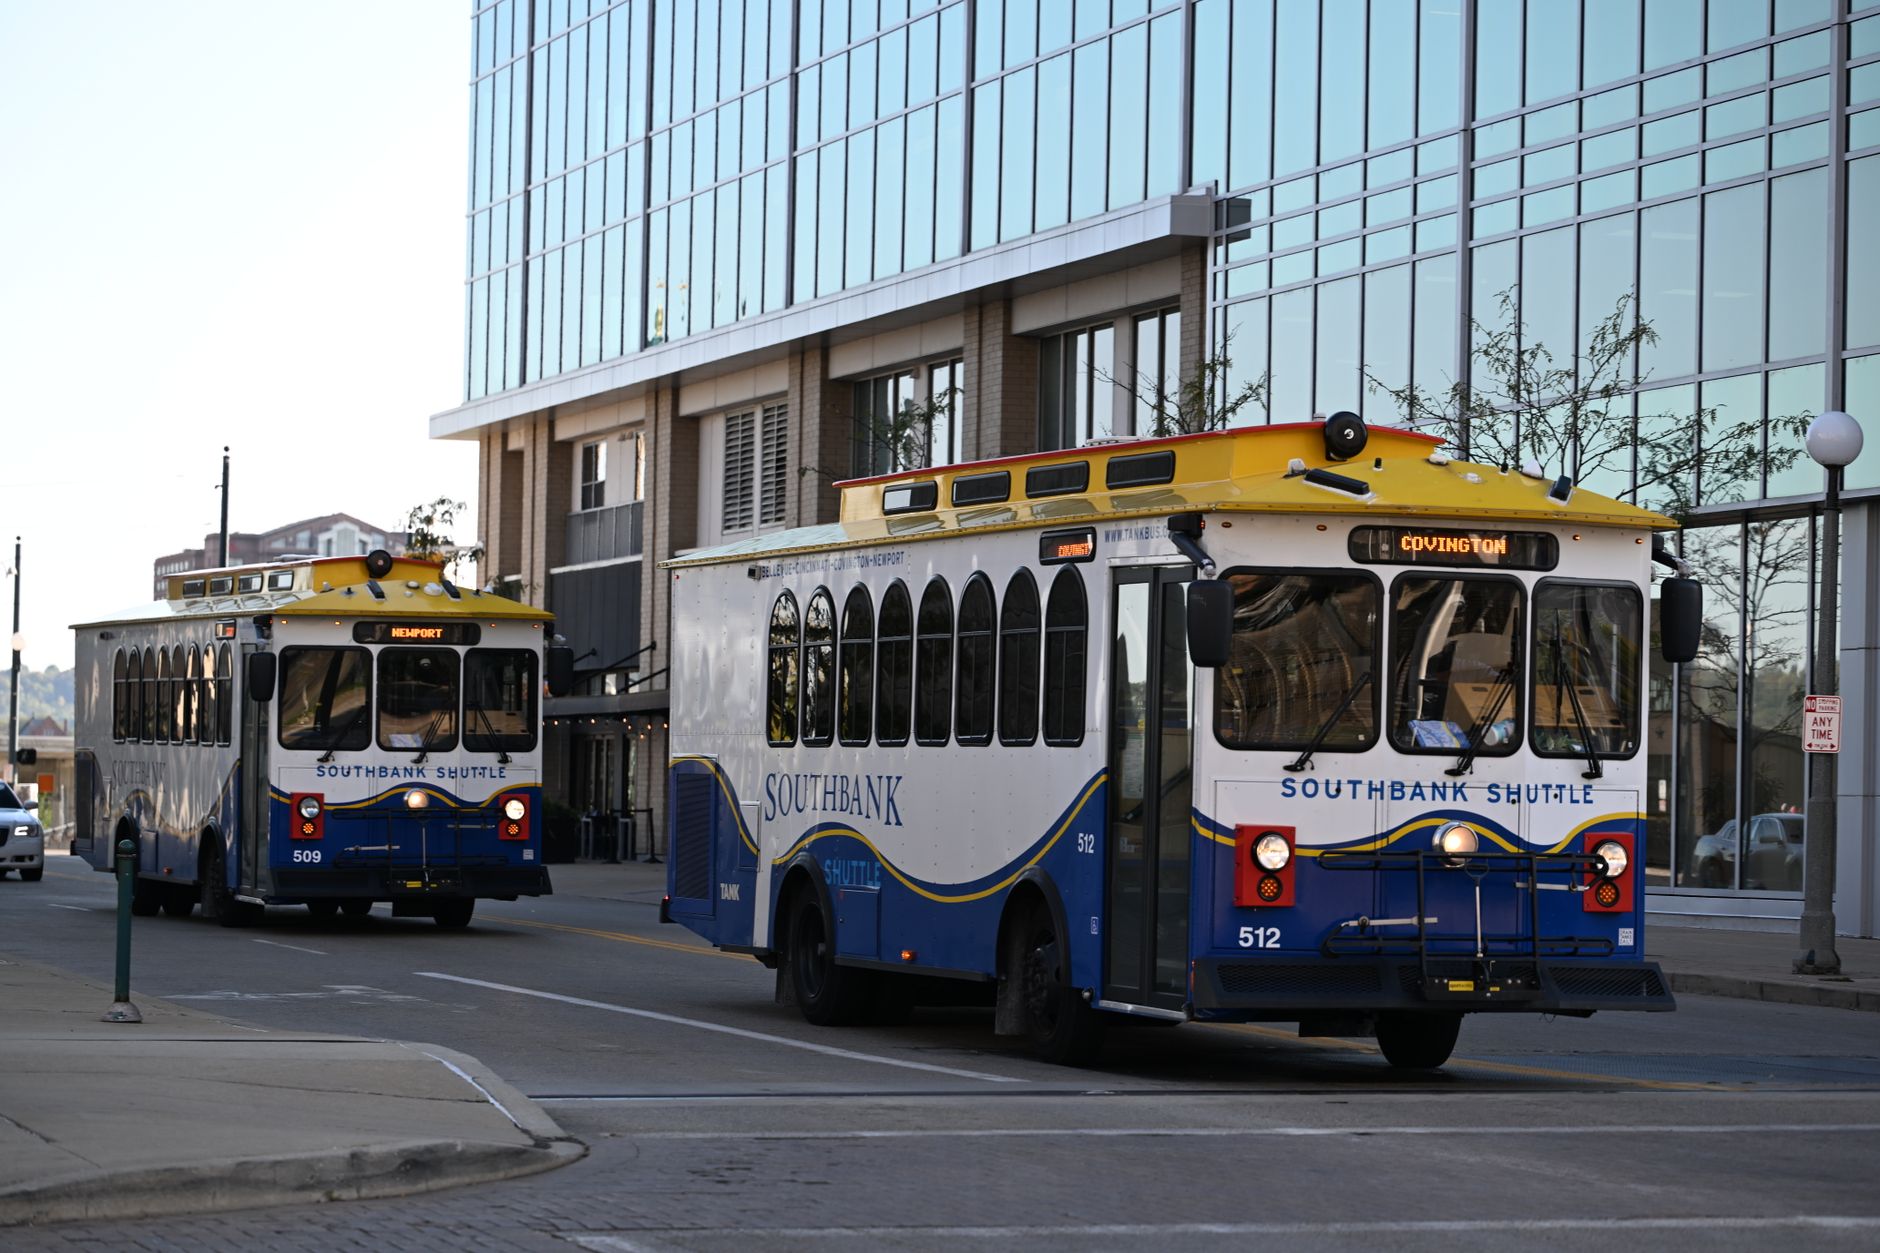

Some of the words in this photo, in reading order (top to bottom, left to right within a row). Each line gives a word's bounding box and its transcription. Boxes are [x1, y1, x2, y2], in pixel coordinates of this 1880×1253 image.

[1104, 525, 1169, 543] WWW.TANKBUS.O
[1401, 536, 1507, 554] COVINGTON
[392, 628, 443, 638] NEWPORT
[1805, 699, 1816, 710] NO
[1812, 717, 1833, 727] ANY
[1811, 729, 1833, 740] TIME
[316, 765, 426, 778] SOUTHBANK
[437, 767, 507, 779] SHUTTLE
[765, 773, 903, 826] SOUTHBANK
[1281, 778, 1469, 802] SOUTHBANK
[1487, 783, 1594, 804] SHUTTLE
[1078, 833, 1095, 853] 512
[293, 850, 322, 863] 509
[824, 859, 881, 887] SHUTTLE
[720, 883, 740, 901] TANK
[1238, 926, 1281, 948] 512
